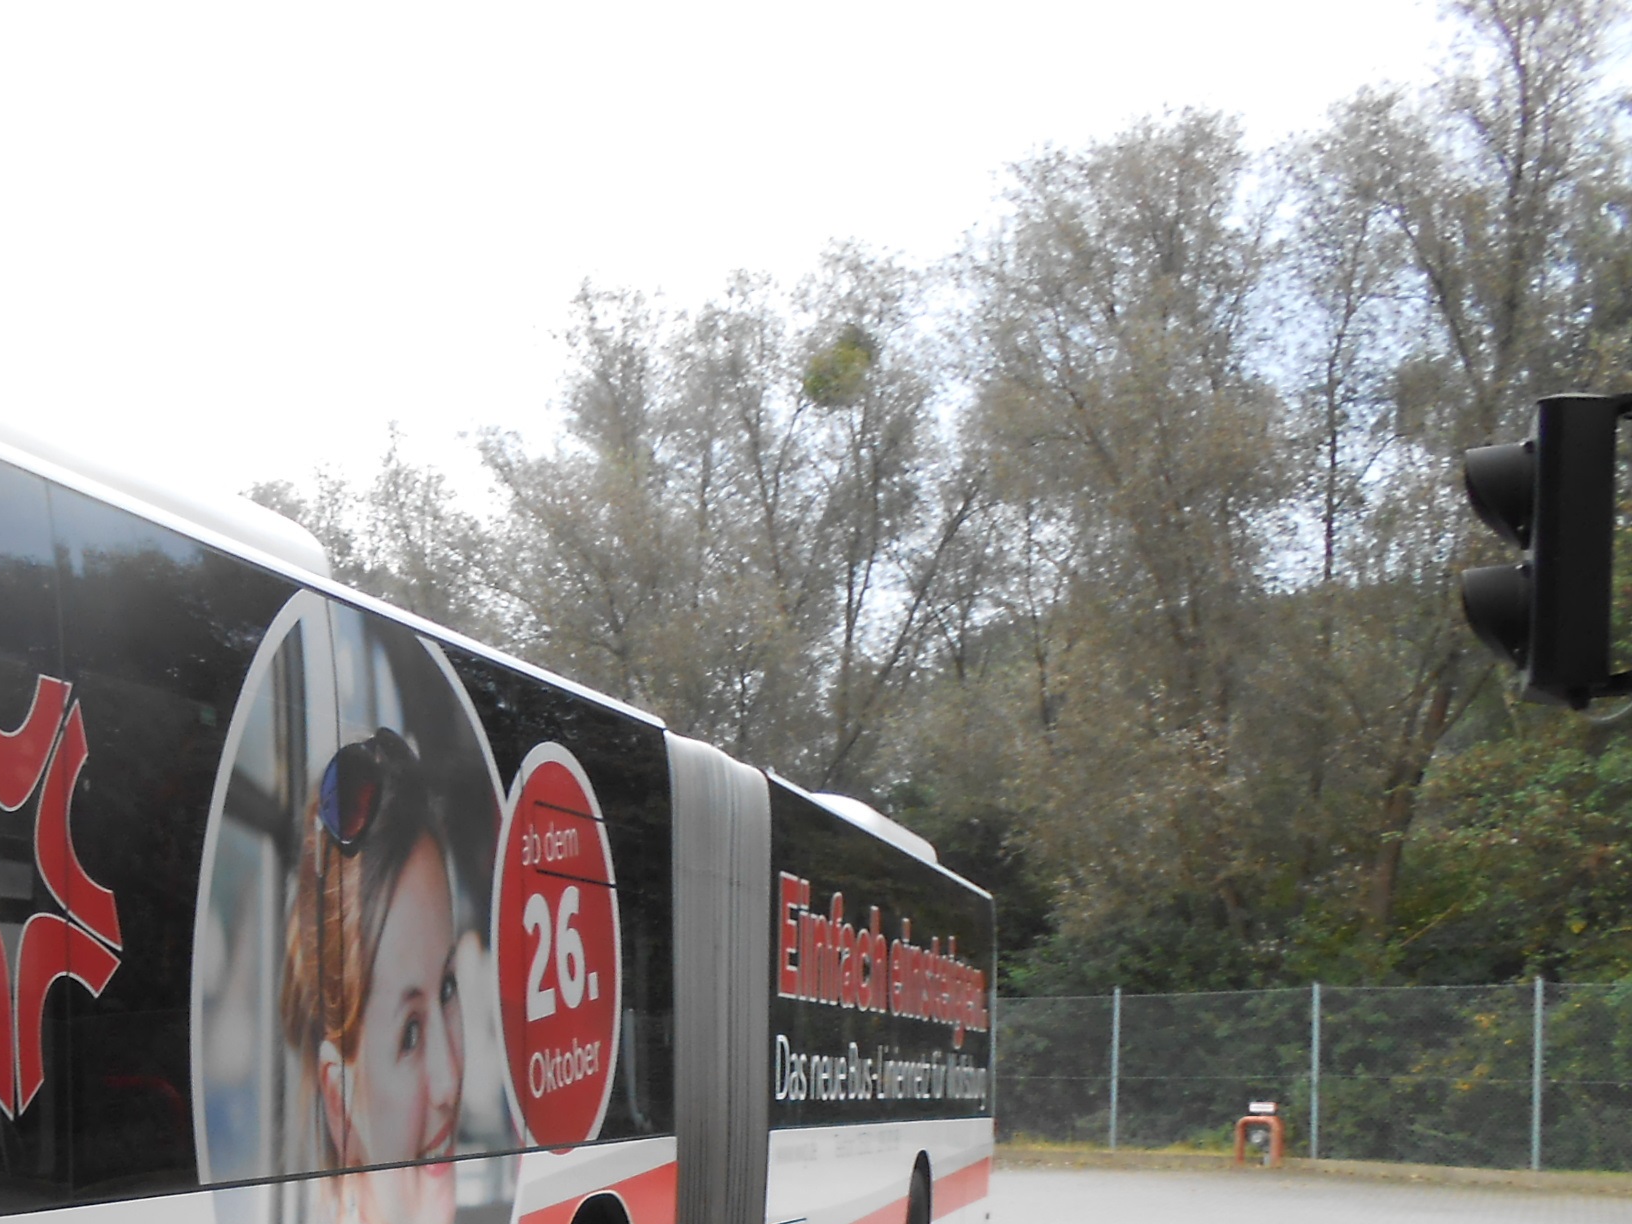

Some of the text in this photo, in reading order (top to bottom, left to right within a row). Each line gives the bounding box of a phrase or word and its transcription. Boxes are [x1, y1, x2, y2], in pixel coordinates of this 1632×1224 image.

[522, 821, 580, 866] ab dem
[522, 885, 600, 1023] 26.
[777, 870, 888, 1014] Einfach
[528, 1037, 601, 1099] Oktober
[775, 1034, 808, 1101] Das
[809, 1054, 847, 1101] neue
